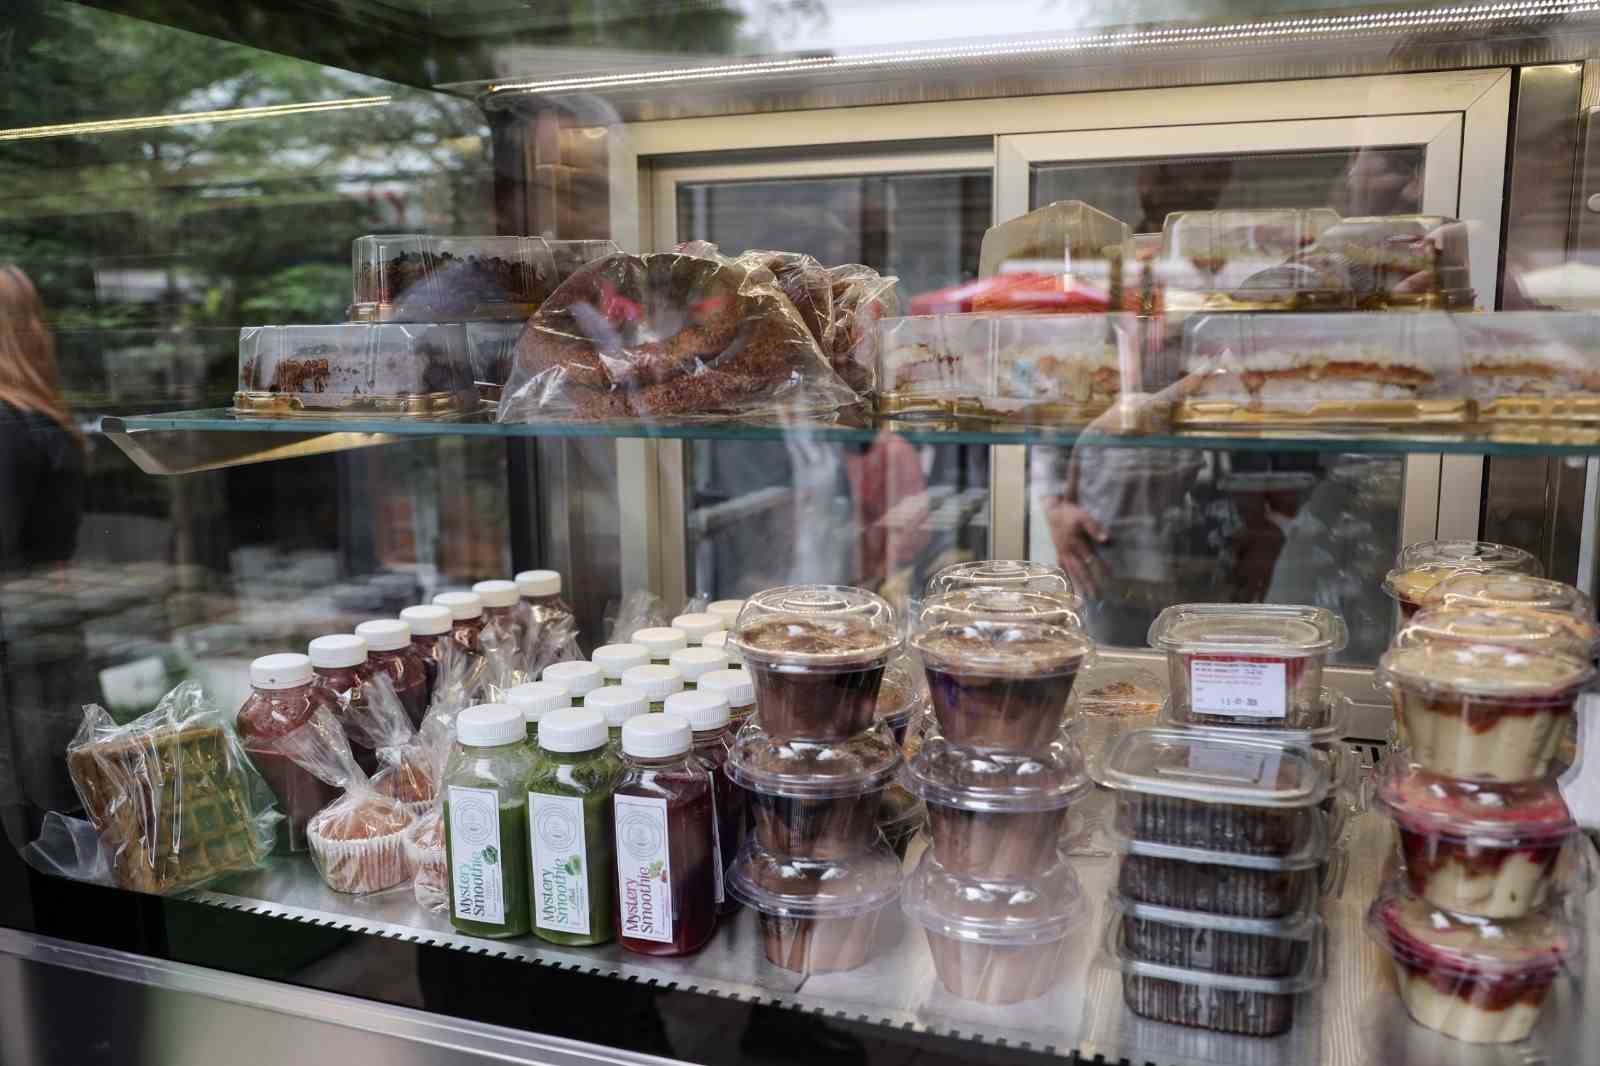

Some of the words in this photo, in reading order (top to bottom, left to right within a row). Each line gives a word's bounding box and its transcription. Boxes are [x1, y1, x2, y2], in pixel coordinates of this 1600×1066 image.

[460, 864, 473, 914] Mystery
[542, 869, 555, 922] Mystery
[553, 858, 569, 924] Smoothie
[626, 877, 641, 932] Mystery
[638, 866, 654, 934] Smoothie
